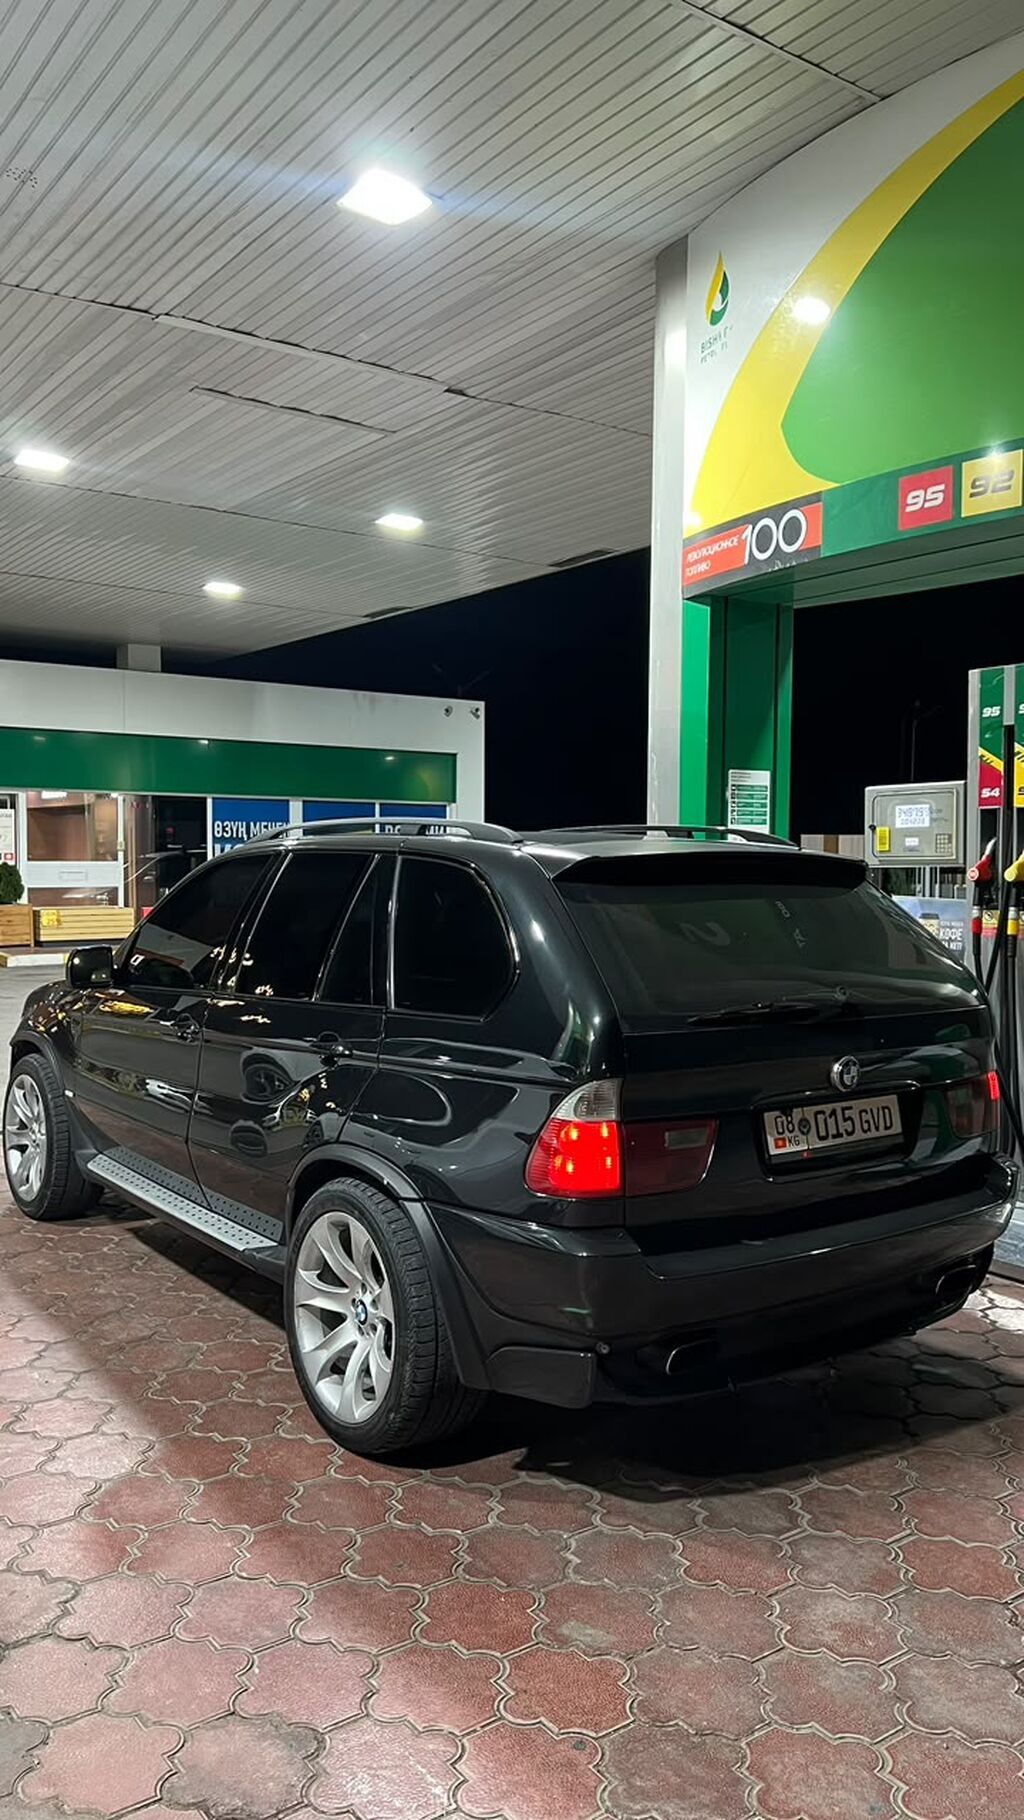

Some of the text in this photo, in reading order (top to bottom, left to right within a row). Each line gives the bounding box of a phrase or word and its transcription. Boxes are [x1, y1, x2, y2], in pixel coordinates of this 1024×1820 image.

[905, 483, 946, 513] 95
[969, 469, 1014, 498] 92
[741, 509, 807, 565] 100
[982, 705, 1001, 718] 95
[980, 787, 1001, 798] 54
[940, 928, 963, 940] КОФЕ
[774, 1106, 893, 1141] 08 015 GVD
